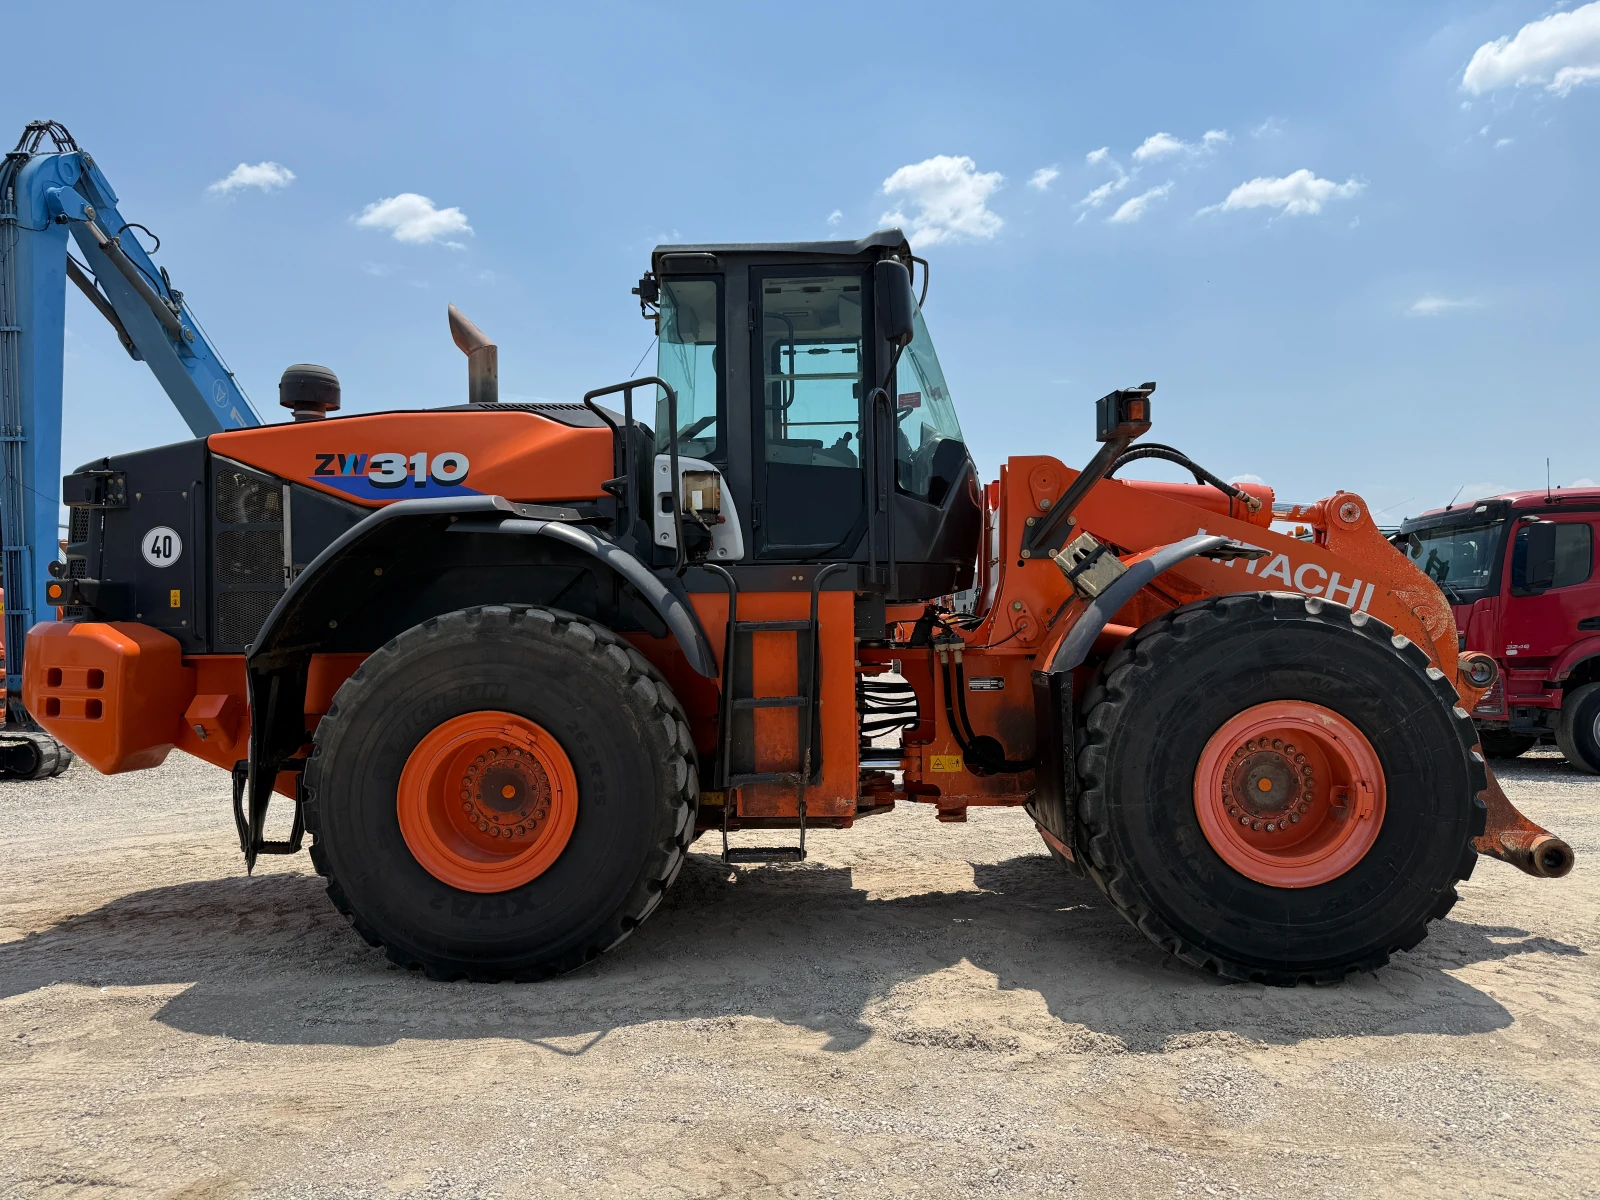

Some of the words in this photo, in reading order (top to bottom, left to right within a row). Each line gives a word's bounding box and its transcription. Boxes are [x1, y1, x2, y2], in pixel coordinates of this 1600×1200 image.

[315, 452, 469, 488] ZW310
[151, 535, 172, 559] 40
[1195, 527, 1375, 612] TACHI
[389, 683, 507, 751] MICHELIN
